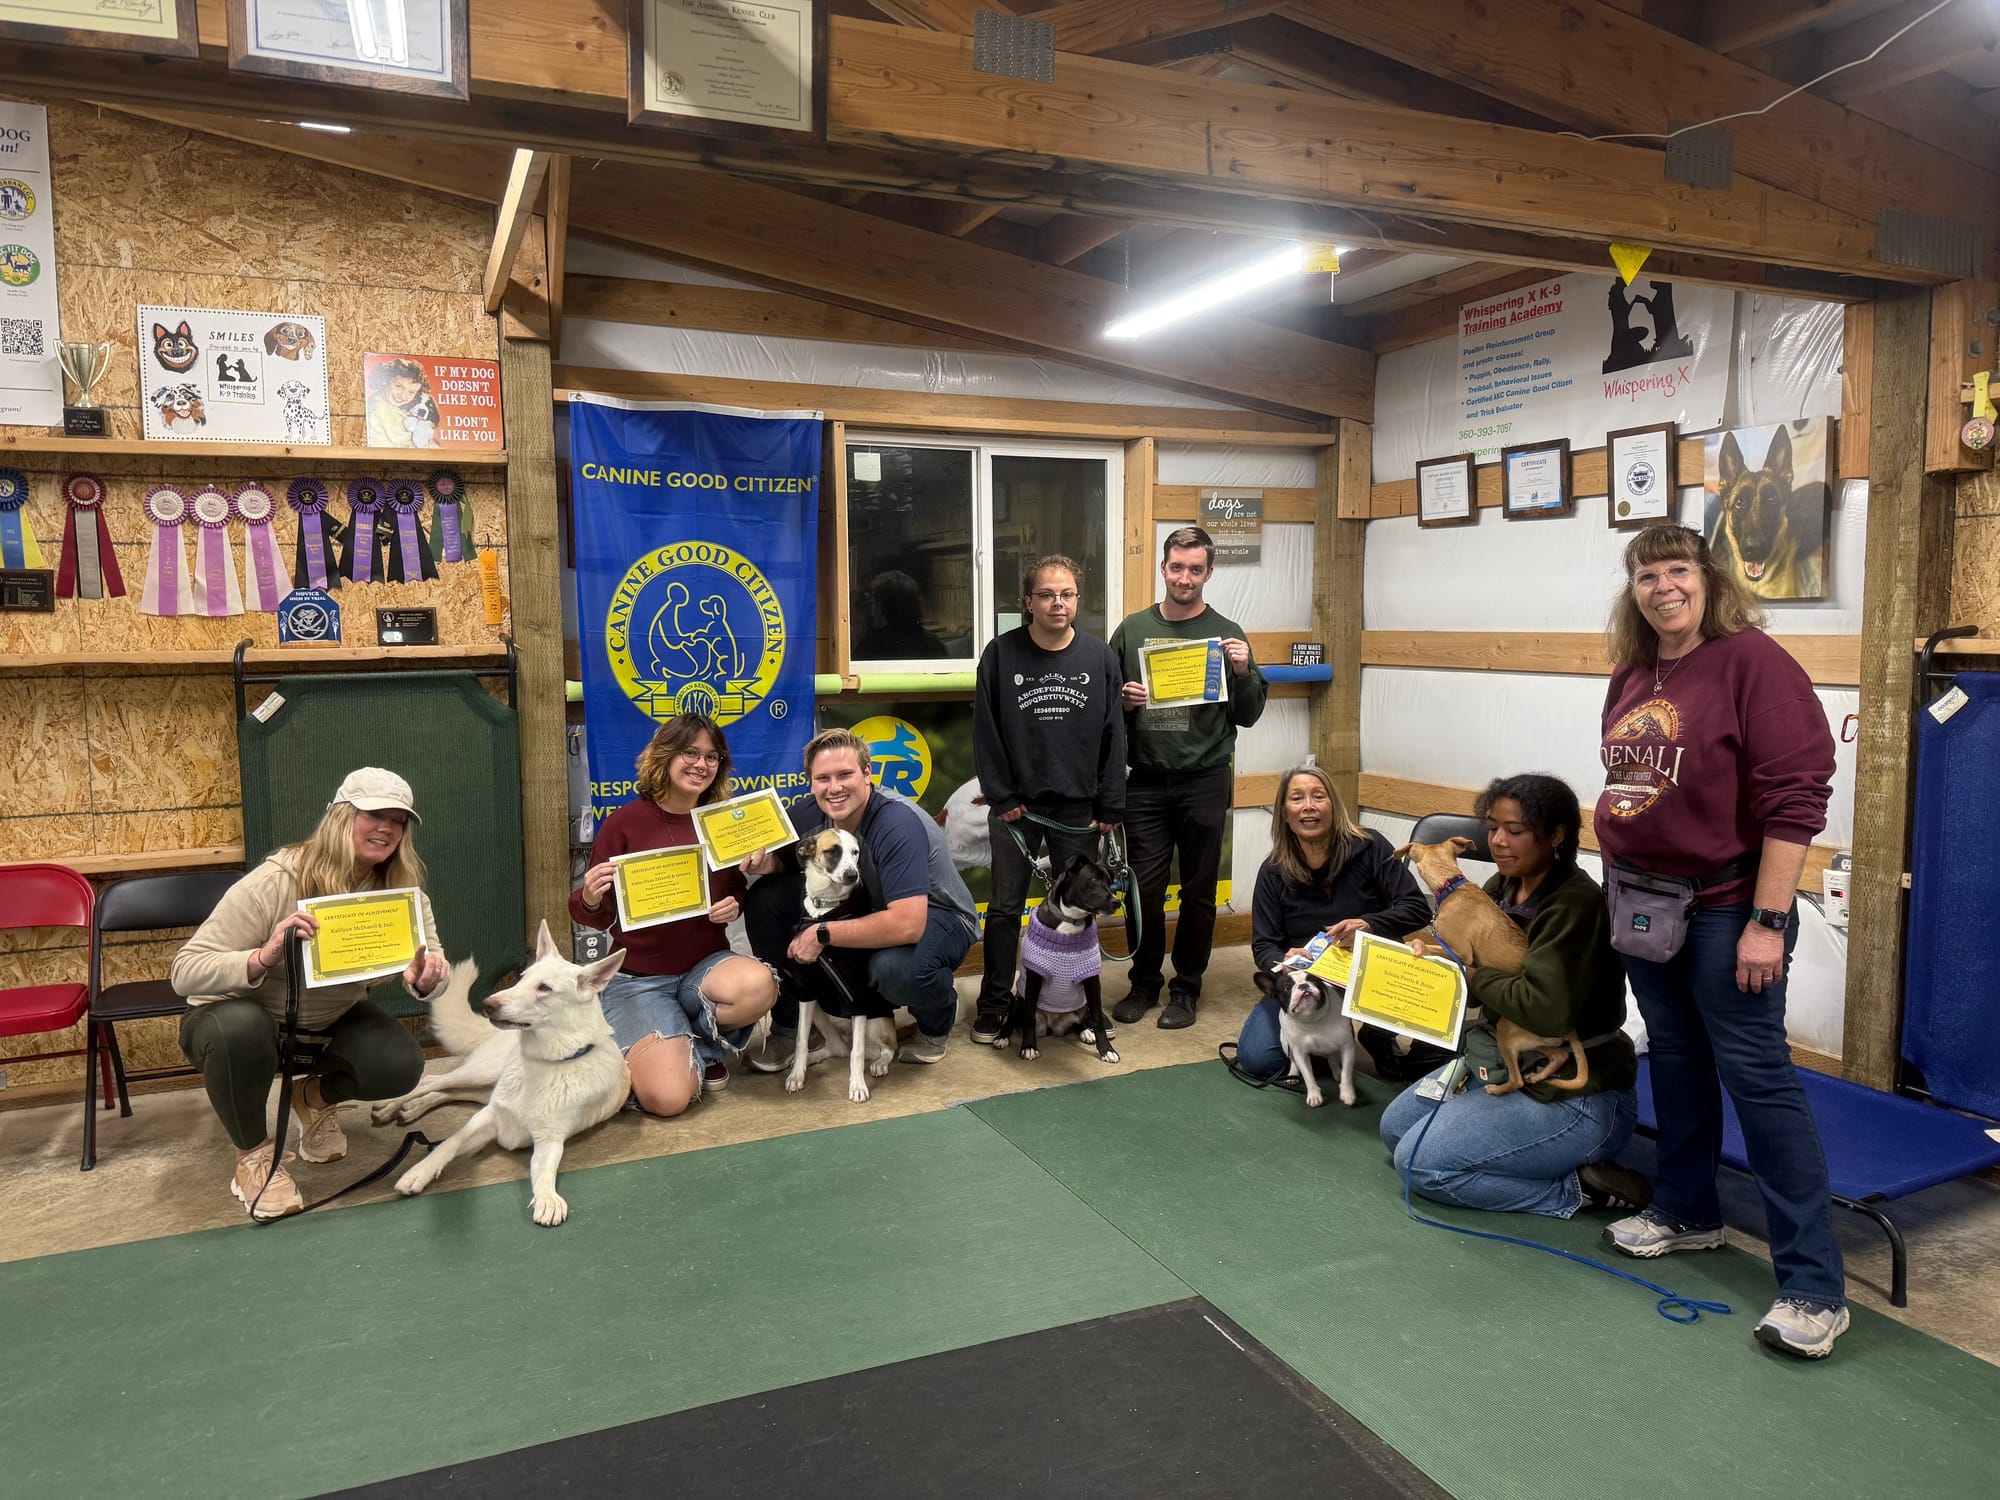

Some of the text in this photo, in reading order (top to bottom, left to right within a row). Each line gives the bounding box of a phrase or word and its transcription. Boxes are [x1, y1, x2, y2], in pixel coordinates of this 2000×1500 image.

[731, 7, 757, 18] KENNEL
[759, 11, 776, 20] CLUB
[1464, 283, 1562, 321] Whispering X K-9
[1463, 300, 1563, 335] Training Academy
[209, 331, 255, 342] SMILES
[1486, 333, 1534, 350] Reinforcement
[1535, 328, 1556, 339] Group
[1462, 361, 1474, 369] and
[1495, 349, 1524, 361] classes!
[1493, 363, 1532, 375] Obedience,
[1533, 357, 1552, 367] Rally,
[434, 366, 495, 379] IF MY DOG
[441, 380, 490, 393] DOESN'T
[1494, 375, 1530, 389] Behavioral
[1603, 366, 1691, 402] Whispering X
[233, 391, 256, 399] Training
[438, 394, 497, 408] LIKE YOU,
[1466, 395, 1493, 406] Certified
[1506, 388, 1531, 398] Canine
[1532, 383, 1550, 393] Good
[1551, 379, 1573, 389] Citizen
[446, 415, 489, 428] I DON'T
[1466, 410, 1479, 419] and
[1480, 407, 1495, 417] Trick
[440, 430, 499, 442] LIKE YOU.
[1458, 422, 1512, 440] 360-393-7097
[1521, 458, 1547, 468] CERTIFICATE
[582, 463, 661, 487] CANINE
[667, 472, 728, 490] GOOD
[1208, 491, 1244, 519] dogs
[1231, 529, 1245, 537] they
[609, 545, 782, 655] CANINE GOOD CITIZEN
[1293, 655, 1321, 666] HEART
[1039, 673, 1066, 683] SALEM
[676, 684, 693, 710] AMERICAN
[694, 683, 713, 696] KENNEL
[1017, 686, 1089, 703] ABCDEFGHIJKLM
[1019, 693, 1086, 711] NOPQRSTUVWXYZ
[684, 691, 712, 716] AKC
[728, 771, 810, 792] OWNERS,
[1612, 770, 1623, 780] THE
[1623, 771, 1634, 781] LAST
[324, 912, 357, 921] CERTIFICATE
[365, 908, 399, 916] ACHIEVEMENT
[1376, 953, 1448, 979] CERTIFICATE OF ACHIEVEMENT
